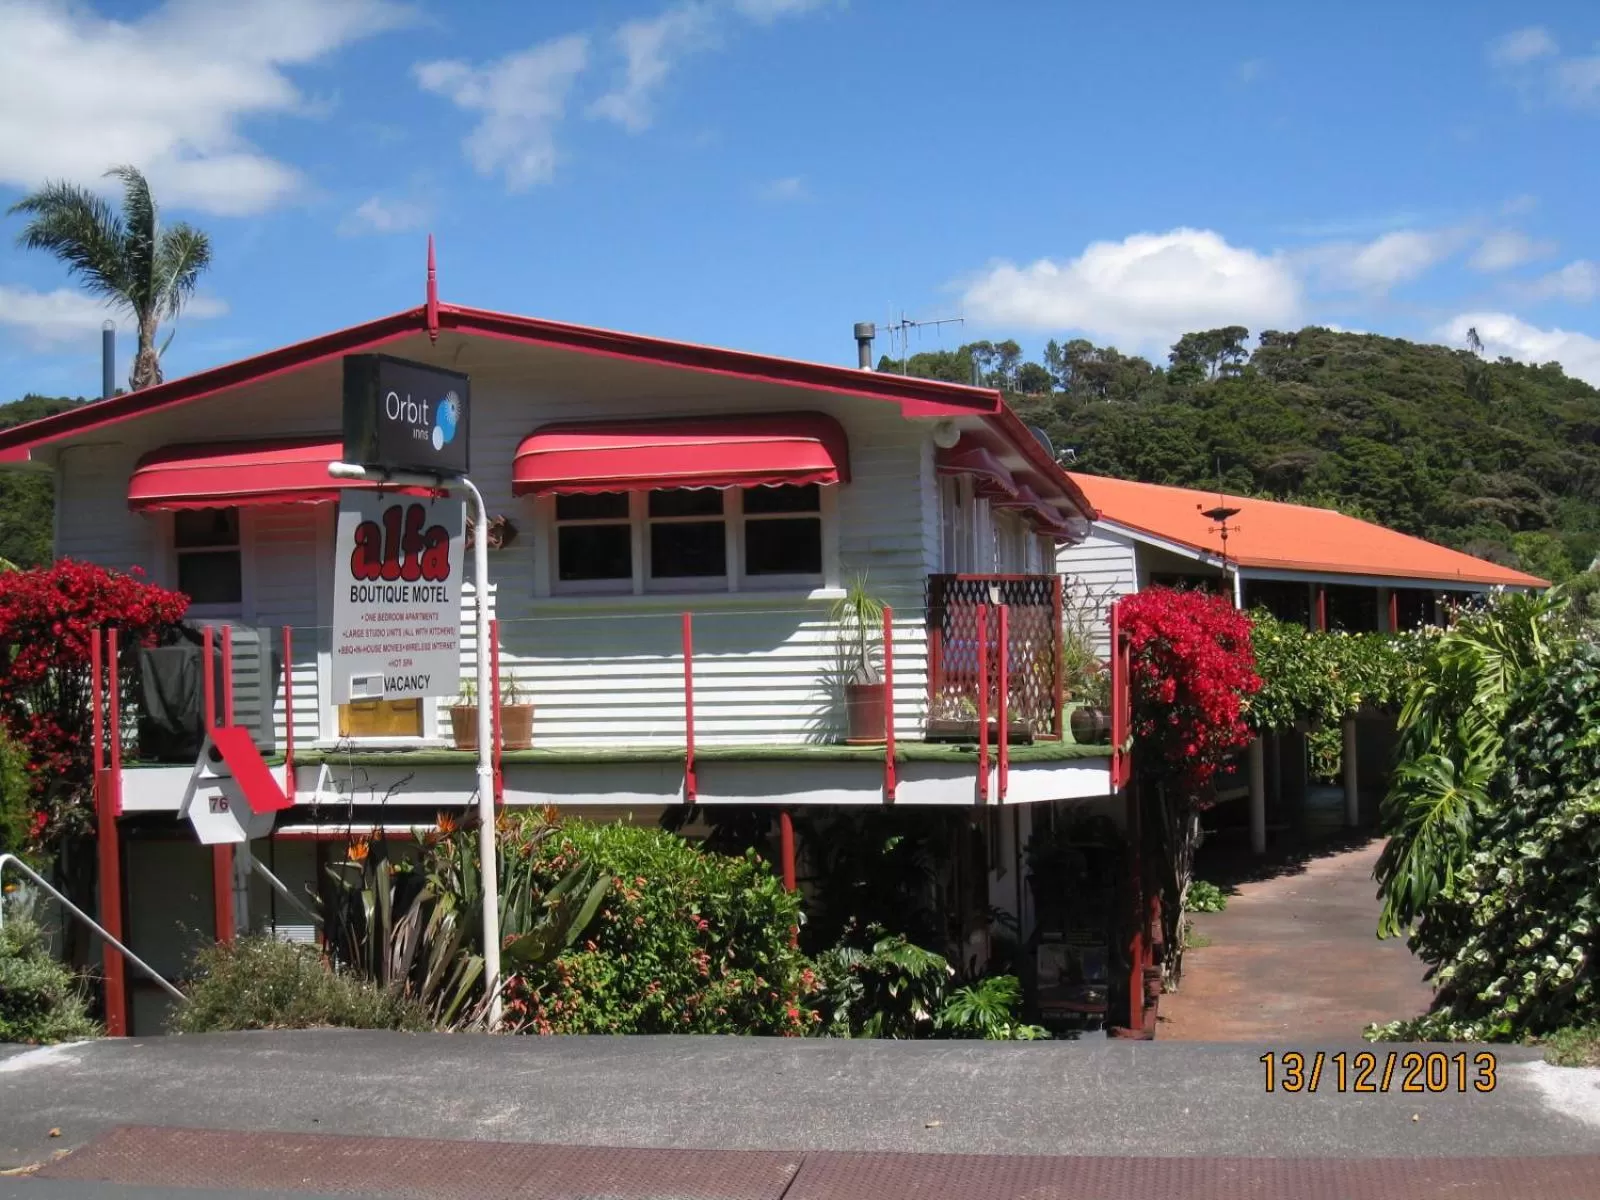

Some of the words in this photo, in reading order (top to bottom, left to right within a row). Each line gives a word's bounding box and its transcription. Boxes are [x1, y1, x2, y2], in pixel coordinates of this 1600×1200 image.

[386, 392, 429, 425] Orbit
[351, 503, 450, 582] alfa
[351, 585, 409, 603] BOUTIQUE
[413, 585, 449, 603] MOTEL
[364, 612, 377, 622] ONE
[378, 612, 404, 621] BEDROOM
[405, 611, 439, 621] APARTMENTS
[345, 628, 364, 638] LARGE
[365, 628, 386, 638] STUDIO
[387, 627, 401, 637] UNITS
[415, 627, 428, 636] WITH
[432, 641, 456, 650] INTERNET
[403, 658, 413, 668] SPA
[384, 674, 430, 692] VACANCY
[209, 797, 228, 811] 76
